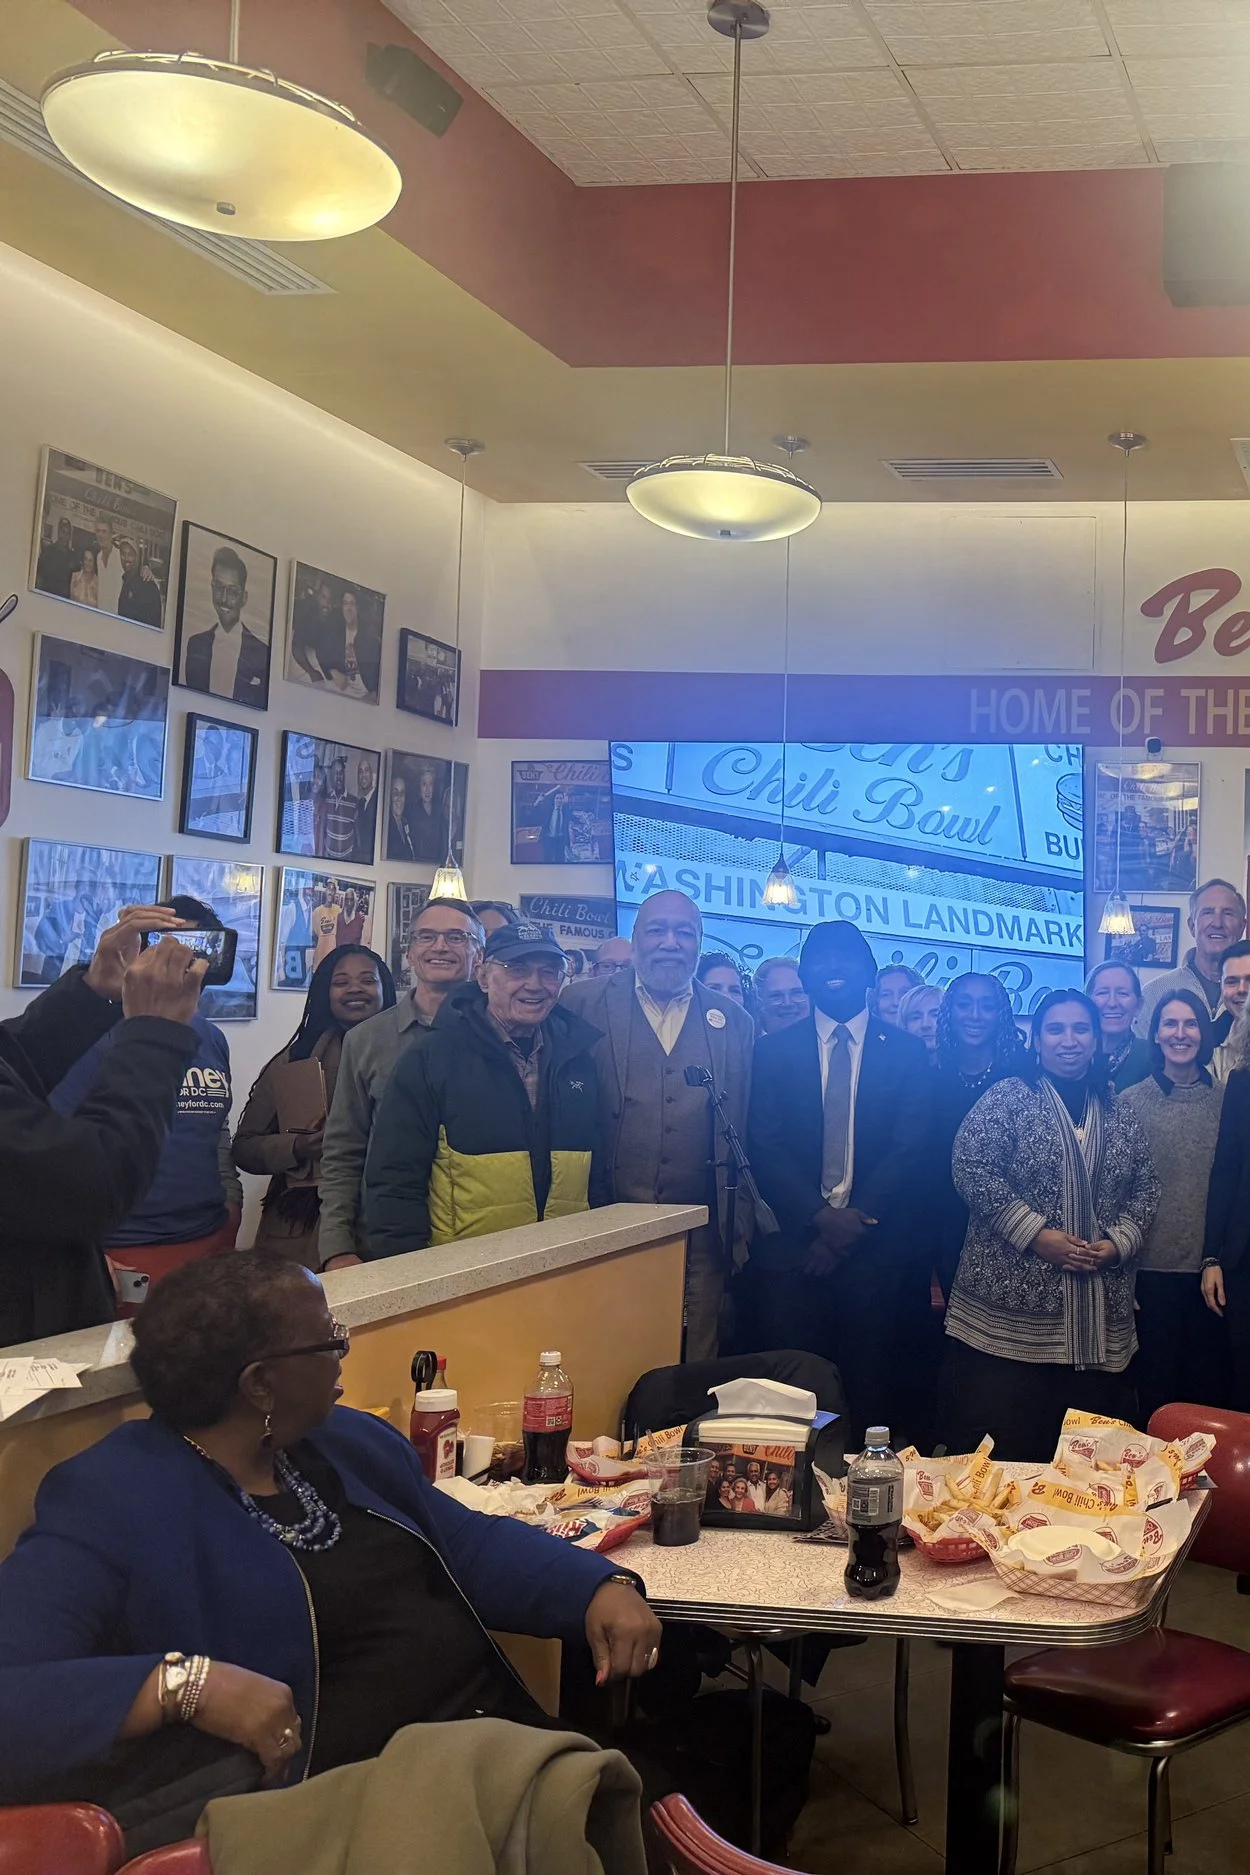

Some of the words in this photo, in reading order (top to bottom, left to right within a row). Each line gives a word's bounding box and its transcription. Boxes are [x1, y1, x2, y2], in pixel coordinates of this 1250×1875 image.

[969, 689, 1091, 735] HOME
[1110, 688, 1164, 735] OF
[702, 746, 840, 814] Chili
[853, 777, 1001, 845] Bowl
[530, 896, 571, 918] Chili
[560, 924, 604, 939] FAMOUS
